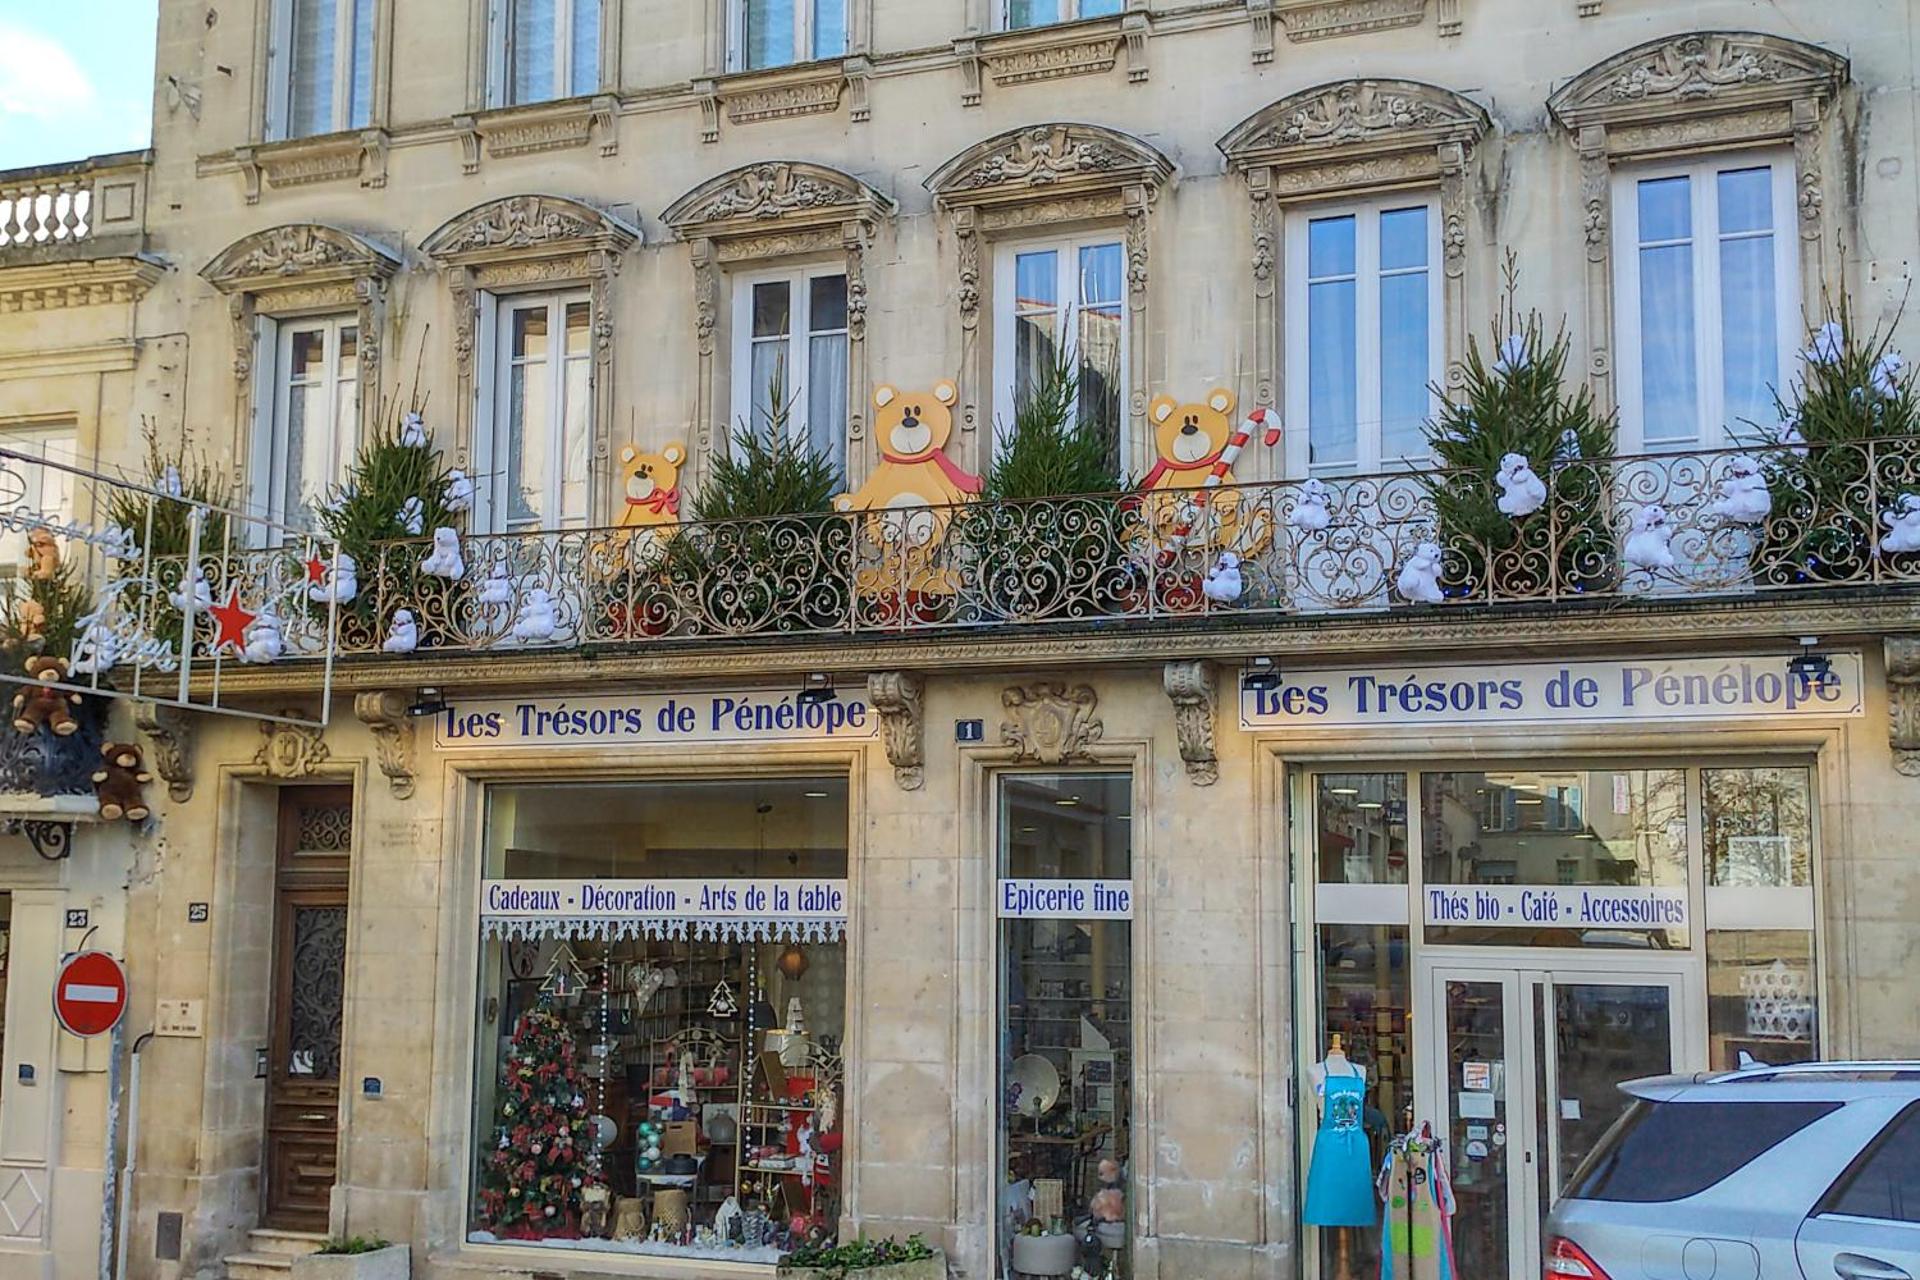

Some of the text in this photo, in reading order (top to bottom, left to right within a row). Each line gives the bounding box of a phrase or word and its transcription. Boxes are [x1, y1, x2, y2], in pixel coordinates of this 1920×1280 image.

[1256, 663, 1842, 716] Les Trésors de Pénélope
[447, 696, 866, 738] Les Trésors de Pénélope
[964, 722, 974, 739] 1
[190, 905, 207, 920] 25
[489, 884, 560, 911] Cadeaux
[582, 884, 676, 911] Décoration
[699, 884, 737, 911] Arts
[745, 884, 766, 911] de
[774, 884, 789, 911] la
[798, 884, 842, 911] table
[1004, 882, 1130, 915] Epicerie fine
[1430, 890, 1469, 920] Thés
[1476, 890, 1500, 921] bio
[1521, 890, 1559, 922] Café
[1580, 892, 1684, 924] Accessoires
[68, 912, 87, 926] 23
